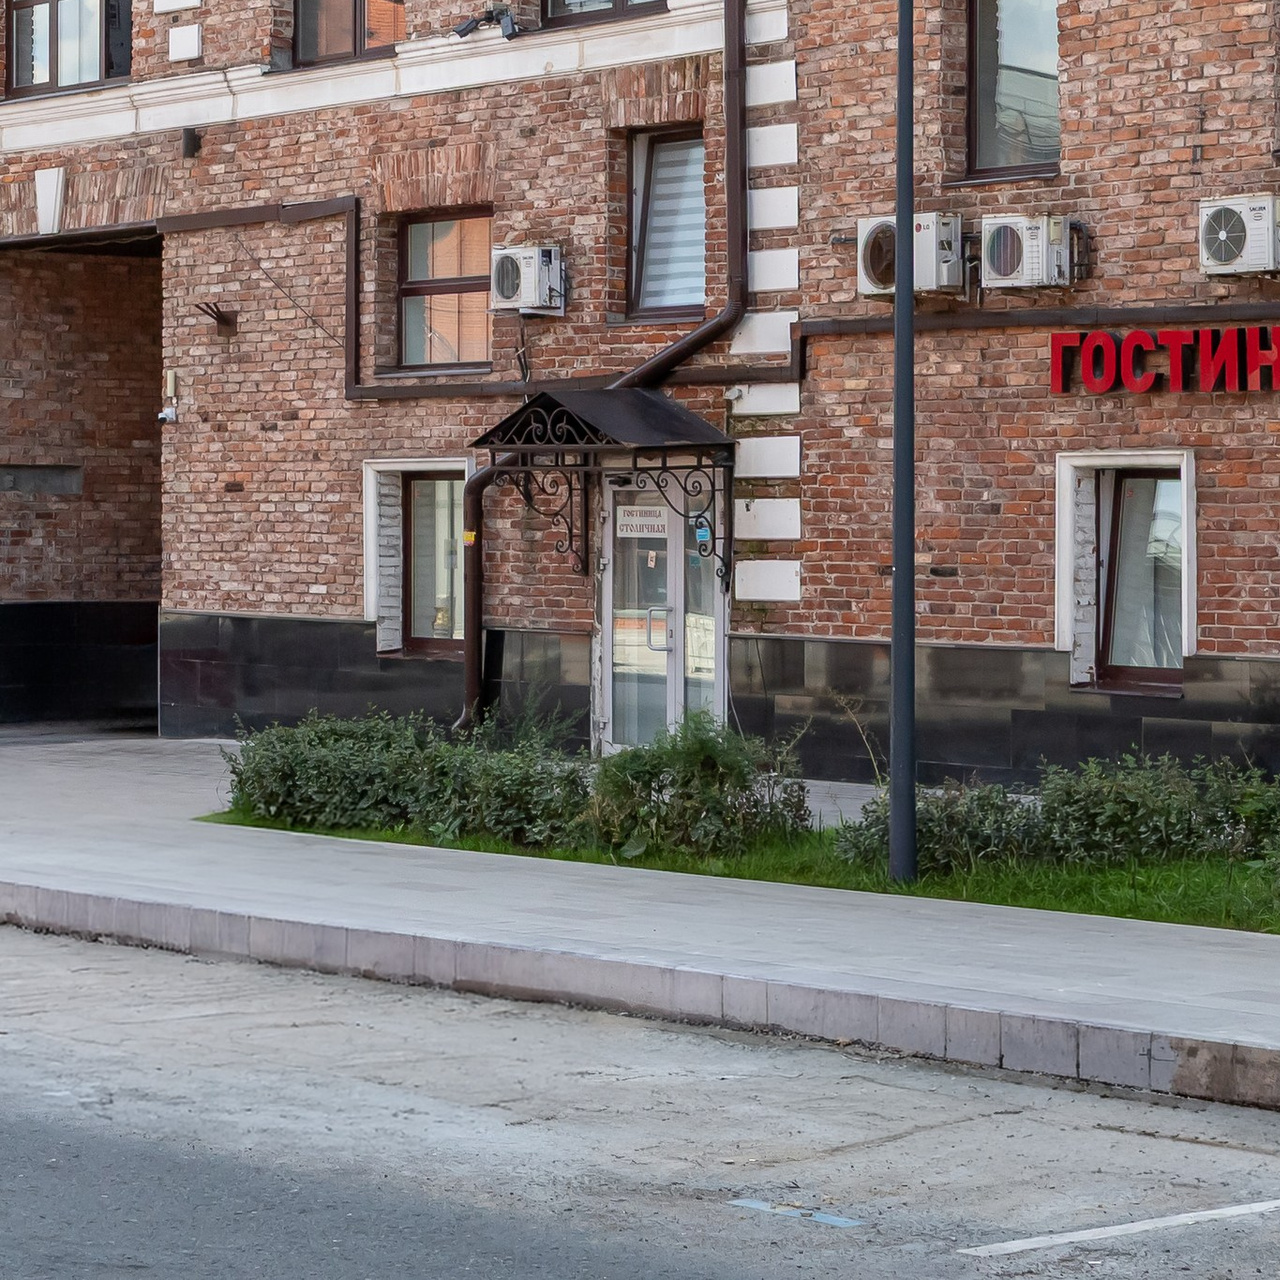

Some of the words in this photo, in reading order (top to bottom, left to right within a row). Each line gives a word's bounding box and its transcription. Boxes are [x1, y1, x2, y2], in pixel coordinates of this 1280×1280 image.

[1050, 328, 1280, 394] ГОСТИН
[623, 509, 662, 519] ГОСТИНИЦА
[619, 523, 666, 534] СТОЛИЧНАЯ
